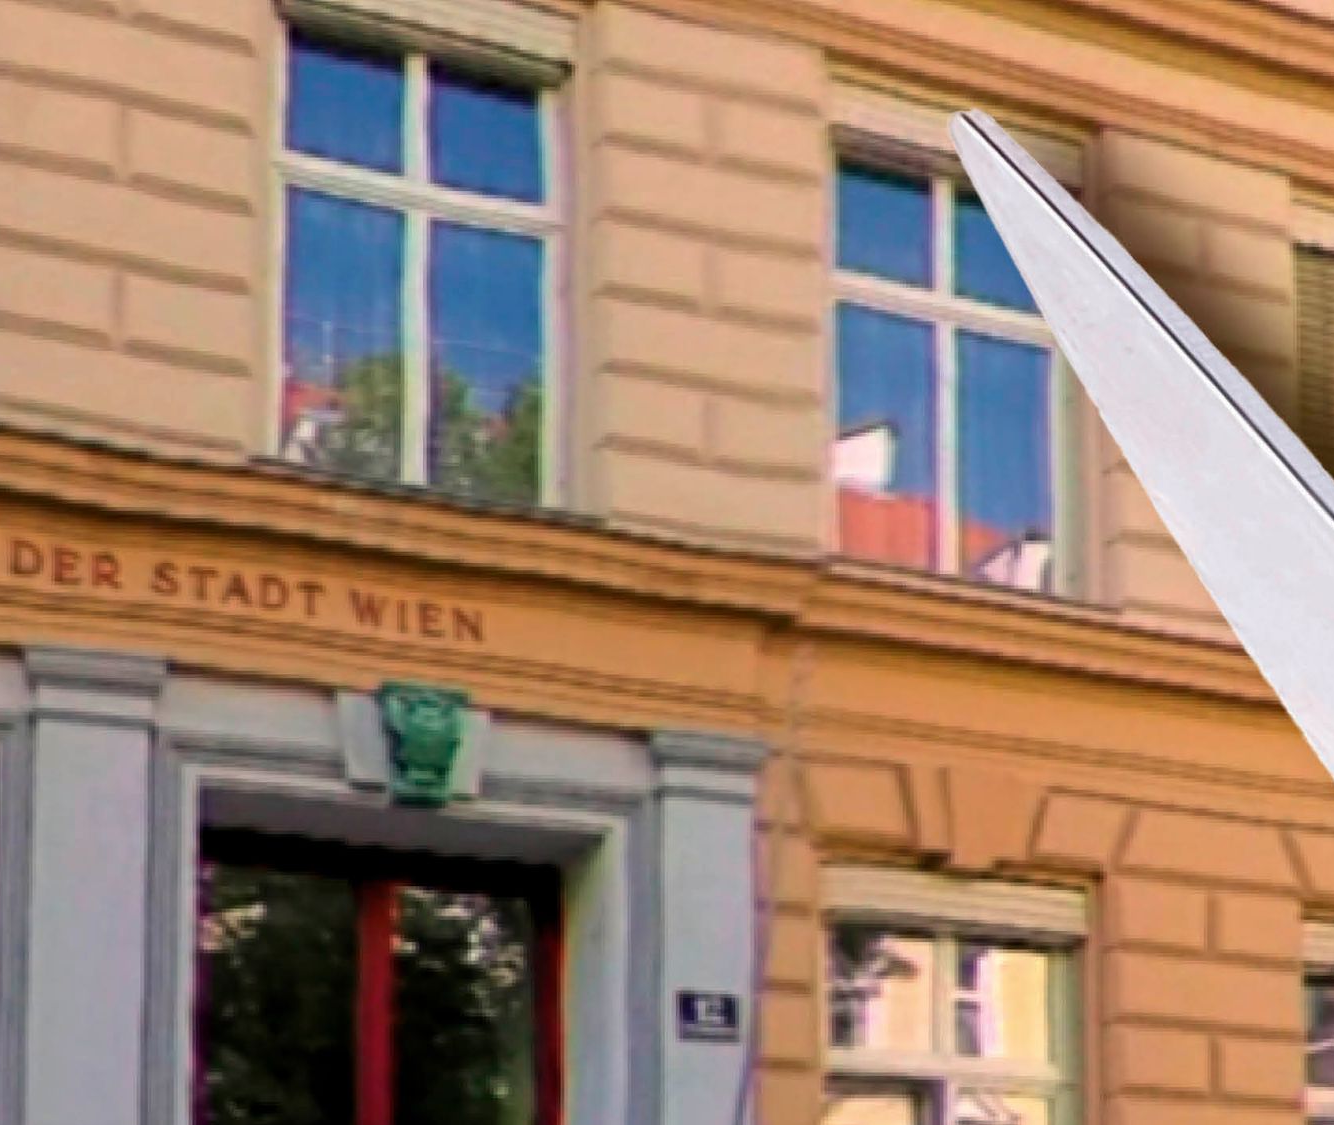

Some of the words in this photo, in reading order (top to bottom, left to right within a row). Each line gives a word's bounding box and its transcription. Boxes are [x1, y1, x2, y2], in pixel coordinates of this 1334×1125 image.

[8, 538, 122, 589] DER
[151, 561, 325, 616] STADT
[347, 587, 484, 642] WIEN
